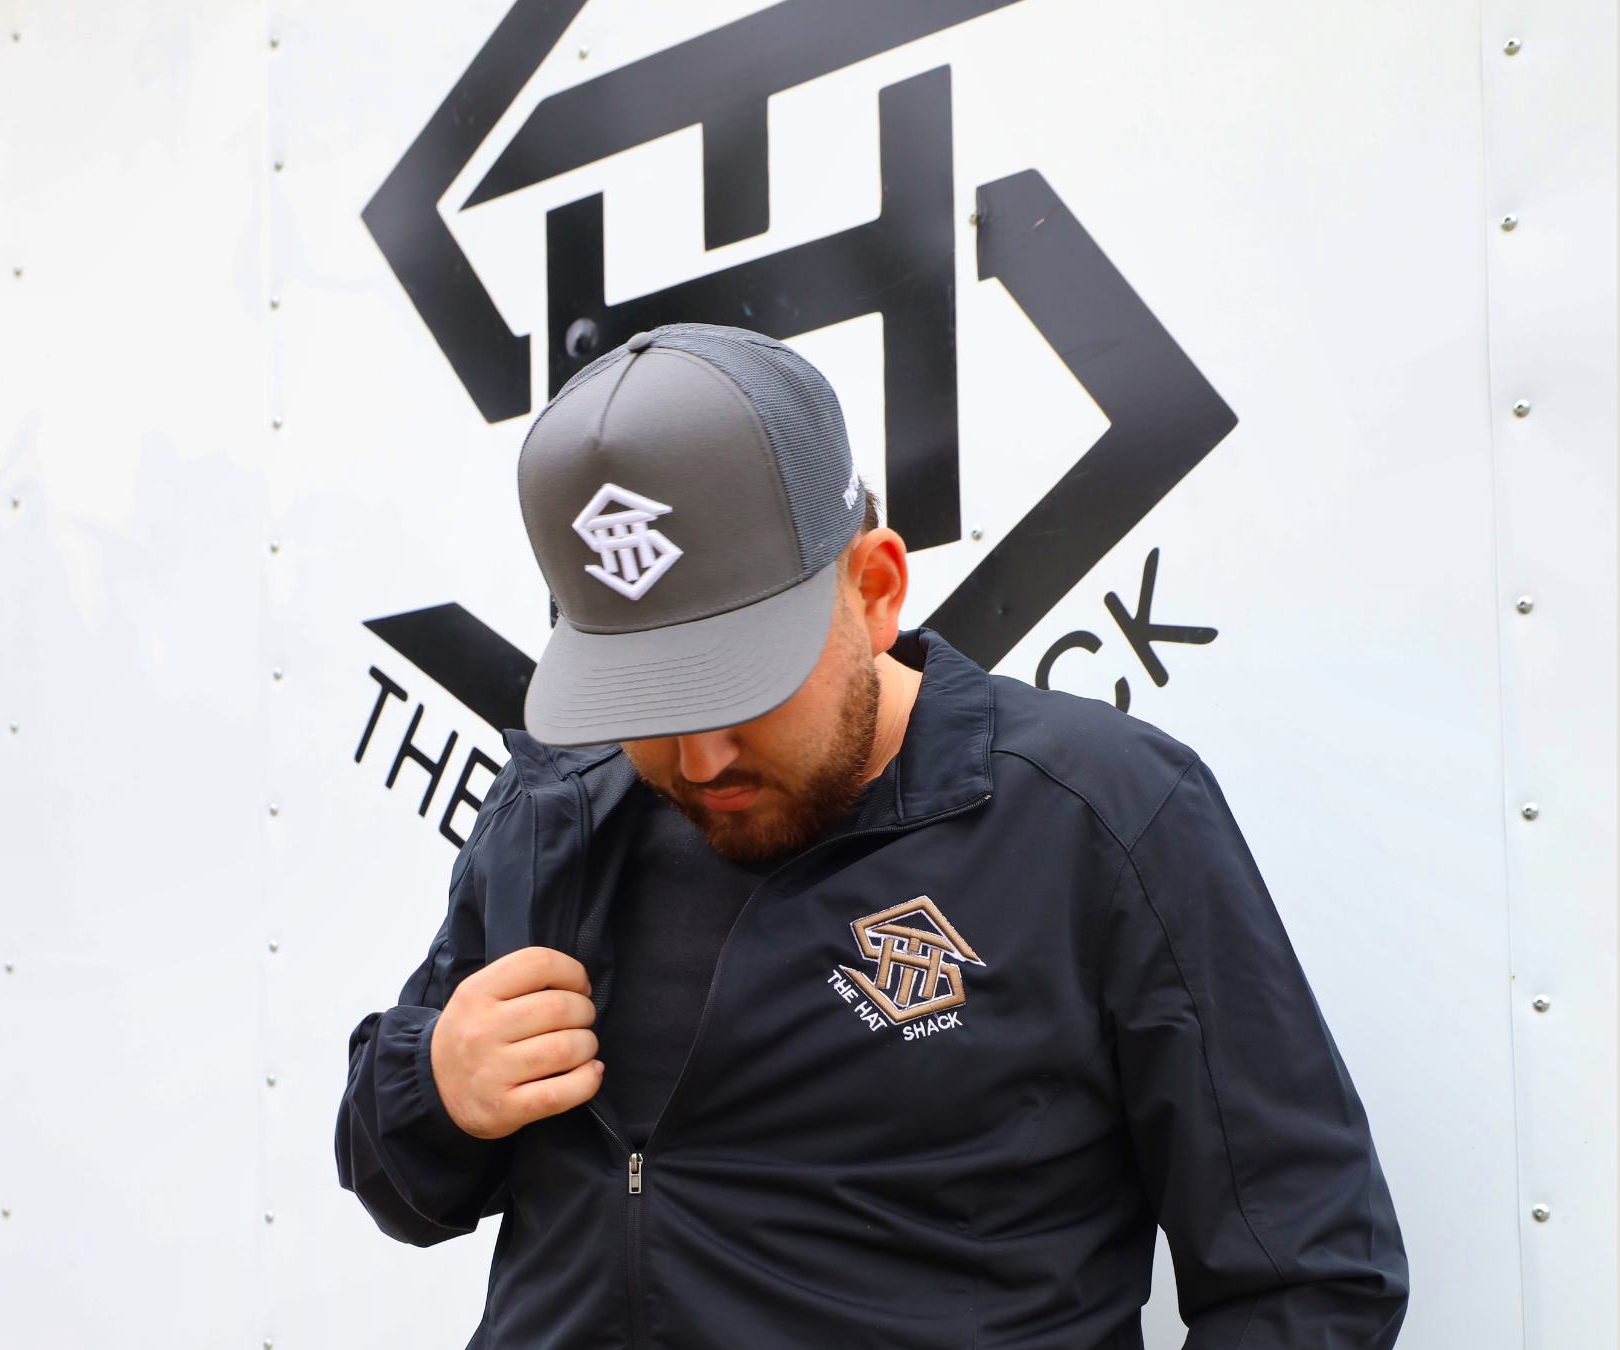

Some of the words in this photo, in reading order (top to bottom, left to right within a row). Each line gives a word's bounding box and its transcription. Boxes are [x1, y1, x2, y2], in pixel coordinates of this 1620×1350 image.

[827, 969, 859, 1004] THE
[854, 1000, 888, 1032] HAT
[902, 1011, 963, 1042] SHACK
